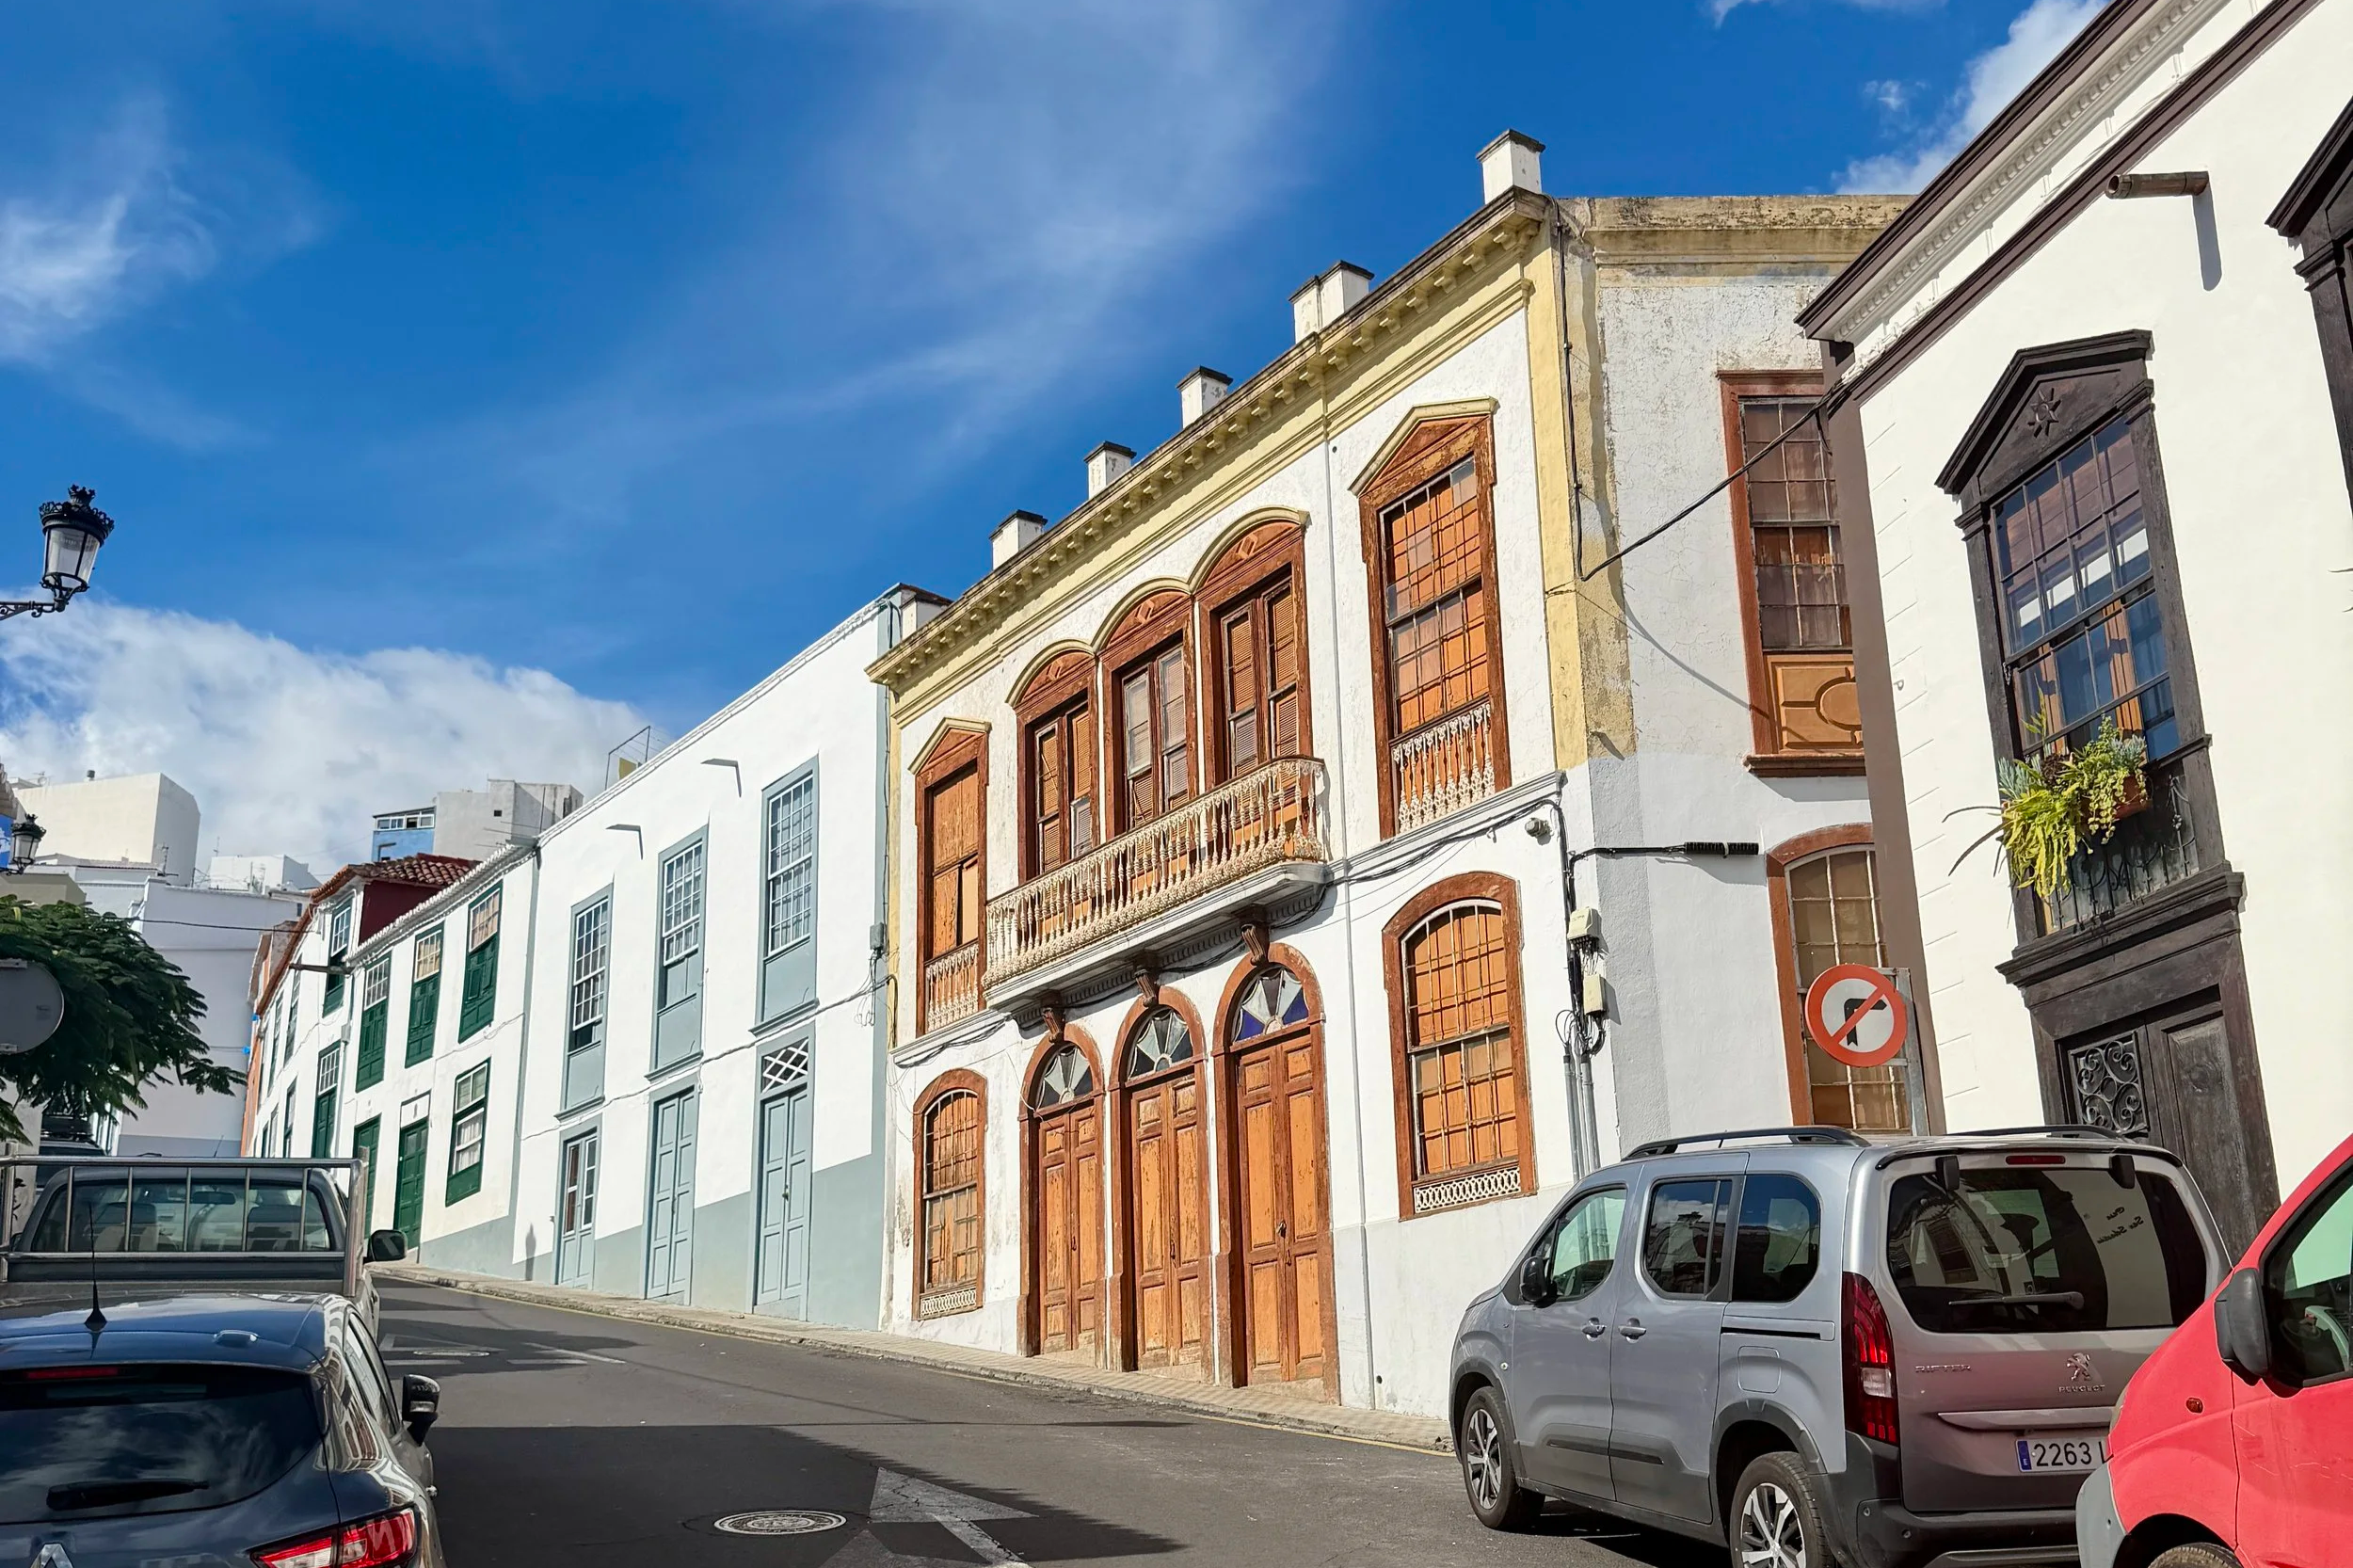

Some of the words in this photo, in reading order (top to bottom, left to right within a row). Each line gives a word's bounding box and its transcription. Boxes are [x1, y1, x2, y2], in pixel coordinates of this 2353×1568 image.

[1914, 1364, 1972, 1374] RIFTER
[2058, 1384, 2105, 1393] PEUGEOT
[2034, 1442, 2092, 1466] 2263
